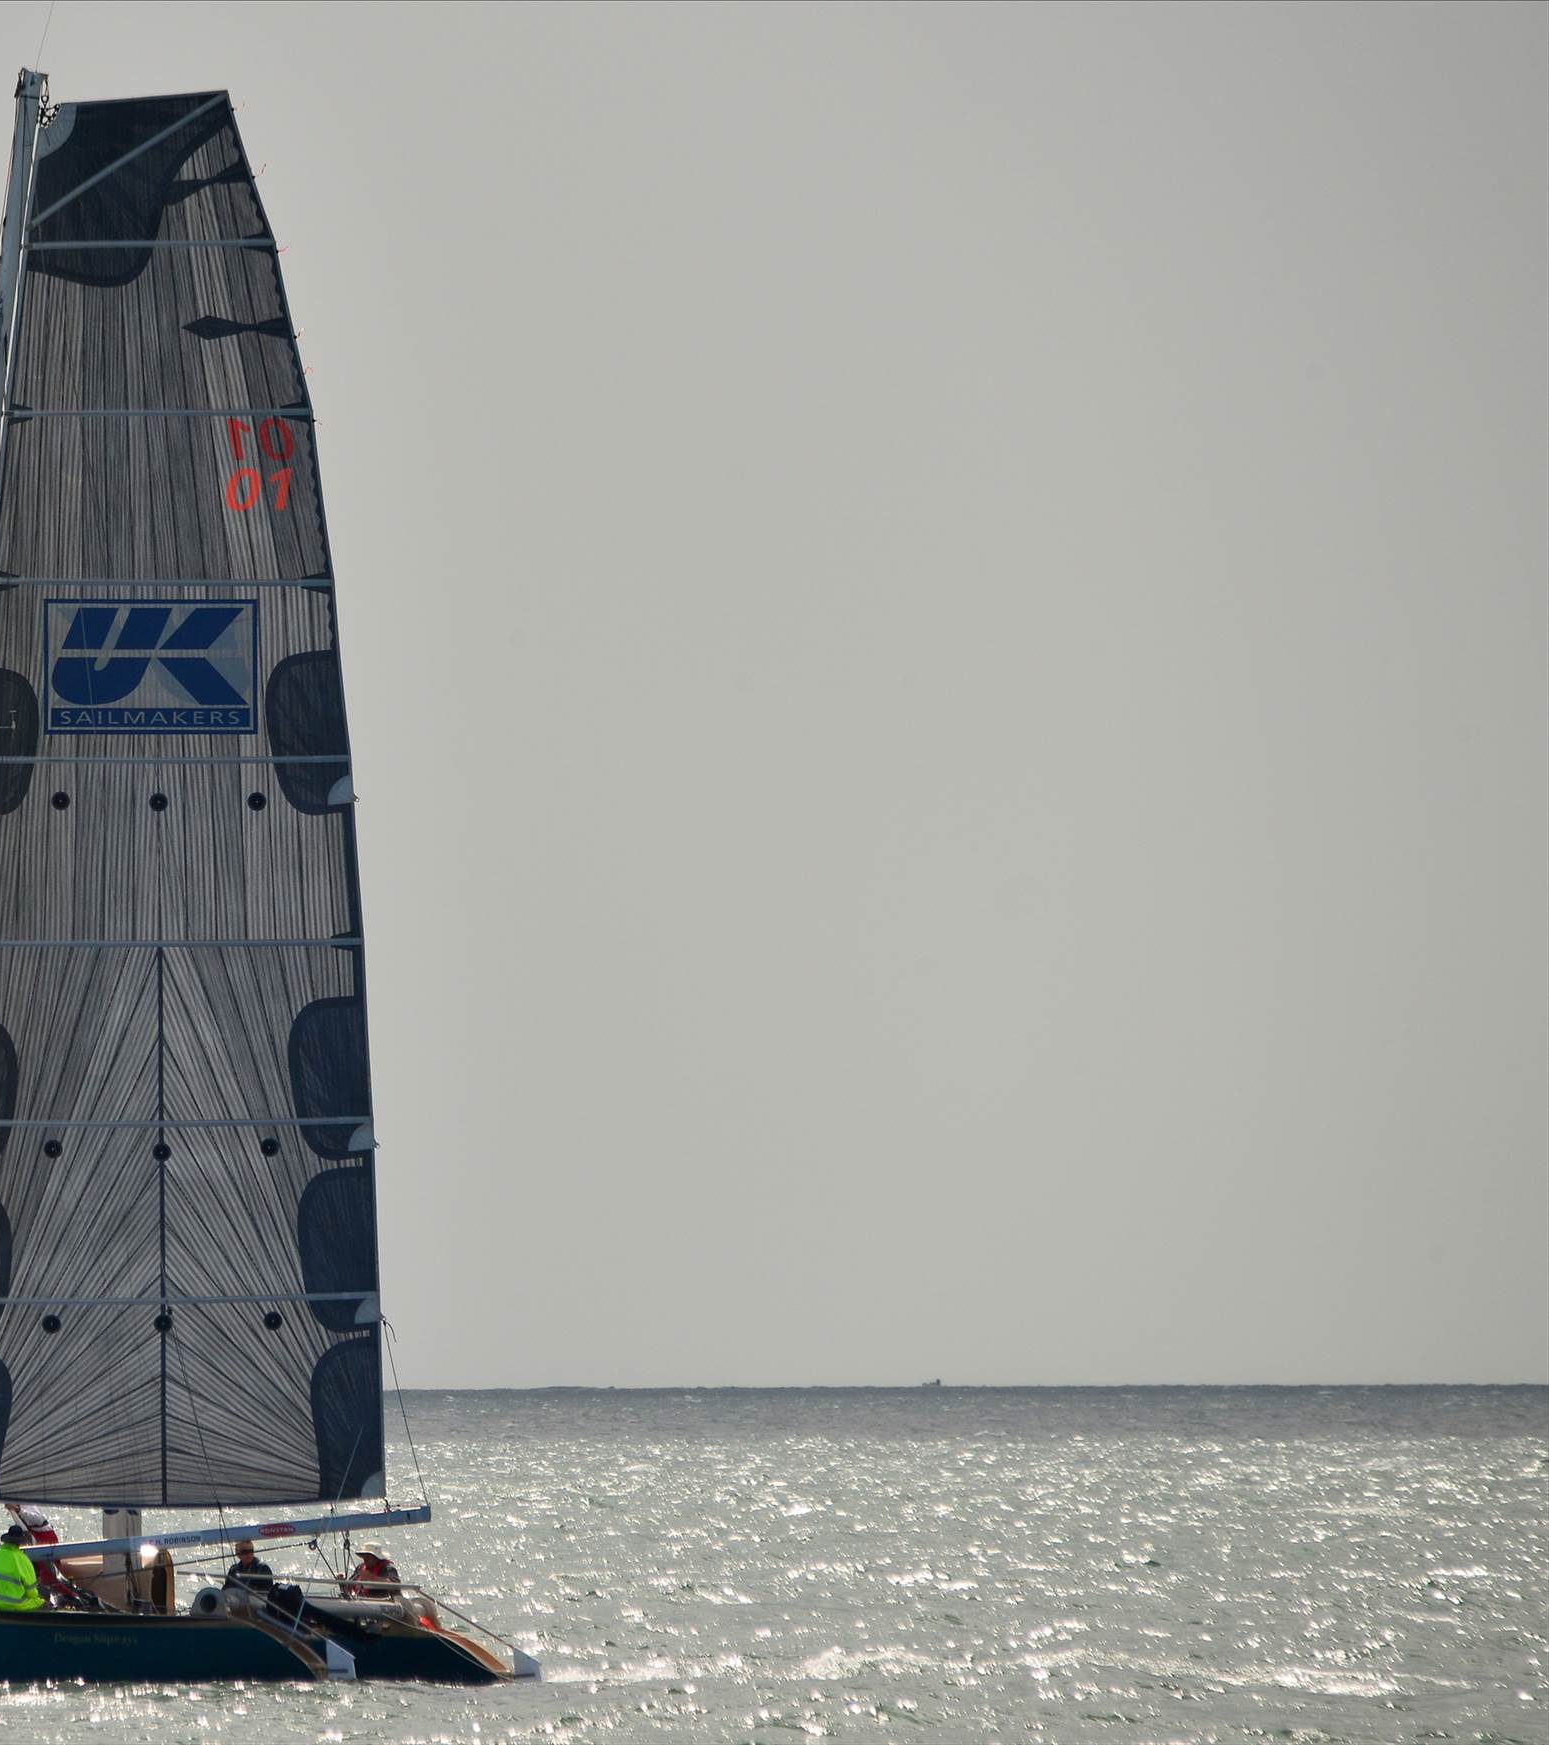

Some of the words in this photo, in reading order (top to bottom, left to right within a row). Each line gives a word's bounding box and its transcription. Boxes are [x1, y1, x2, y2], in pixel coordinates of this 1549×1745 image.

[225, 467, 294, 512] 01
[52, 607, 249, 705] UK
[60, 710, 241, 725] SAILMAKERS
[164, 1535, 201, 1546] ROBINSON
